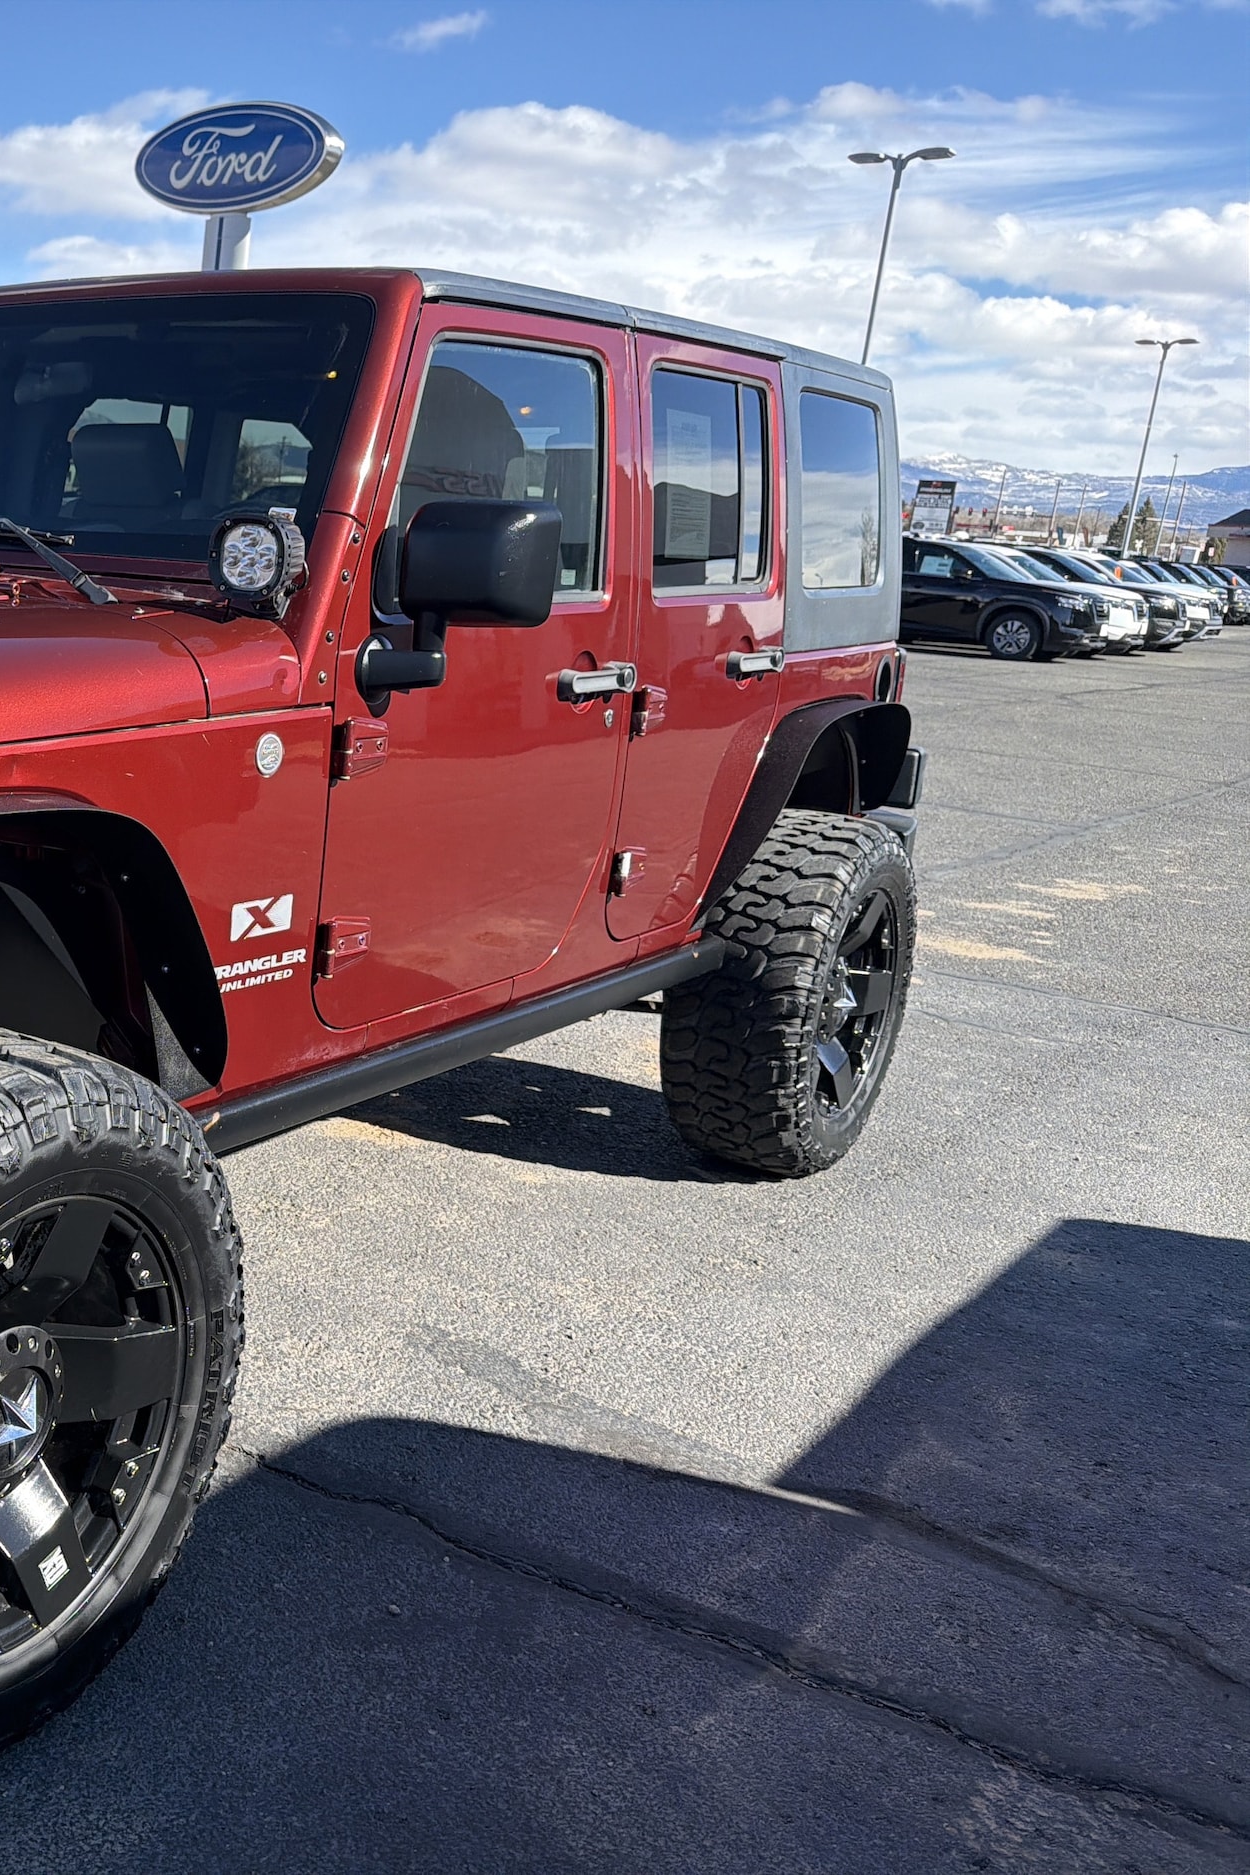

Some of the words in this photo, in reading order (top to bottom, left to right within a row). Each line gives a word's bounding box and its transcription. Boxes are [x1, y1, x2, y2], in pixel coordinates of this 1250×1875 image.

[170, 124, 283, 189] Ford
[214, 948, 306, 980] RANGLER
[182, 1306, 225, 1496] PATRIOT
